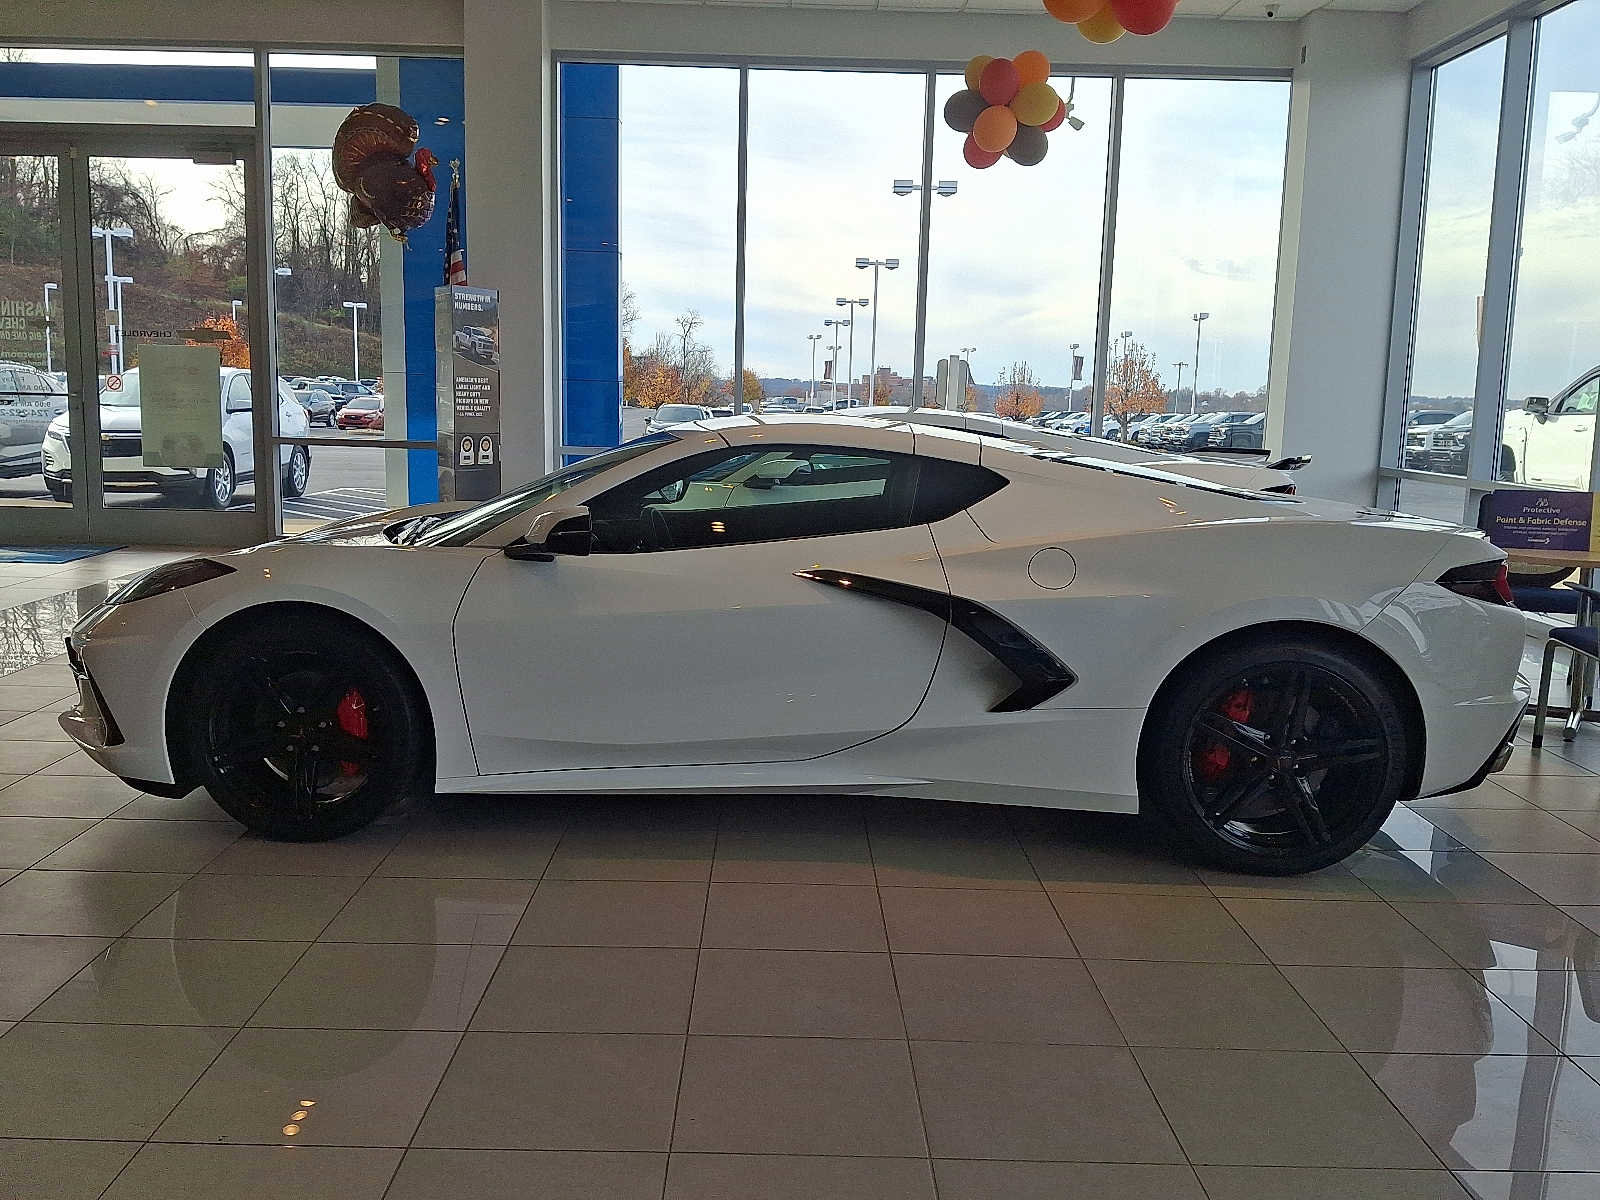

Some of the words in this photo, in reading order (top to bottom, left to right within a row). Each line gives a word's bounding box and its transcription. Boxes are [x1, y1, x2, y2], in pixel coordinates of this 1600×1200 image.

[1522, 506, 1561, 514] Protective
[1496, 515, 1517, 524] Paint
[1518, 516, 1526, 524] &
[1527, 516, 1552, 525] Fabric
[1553, 517, 1588, 527] Defense
